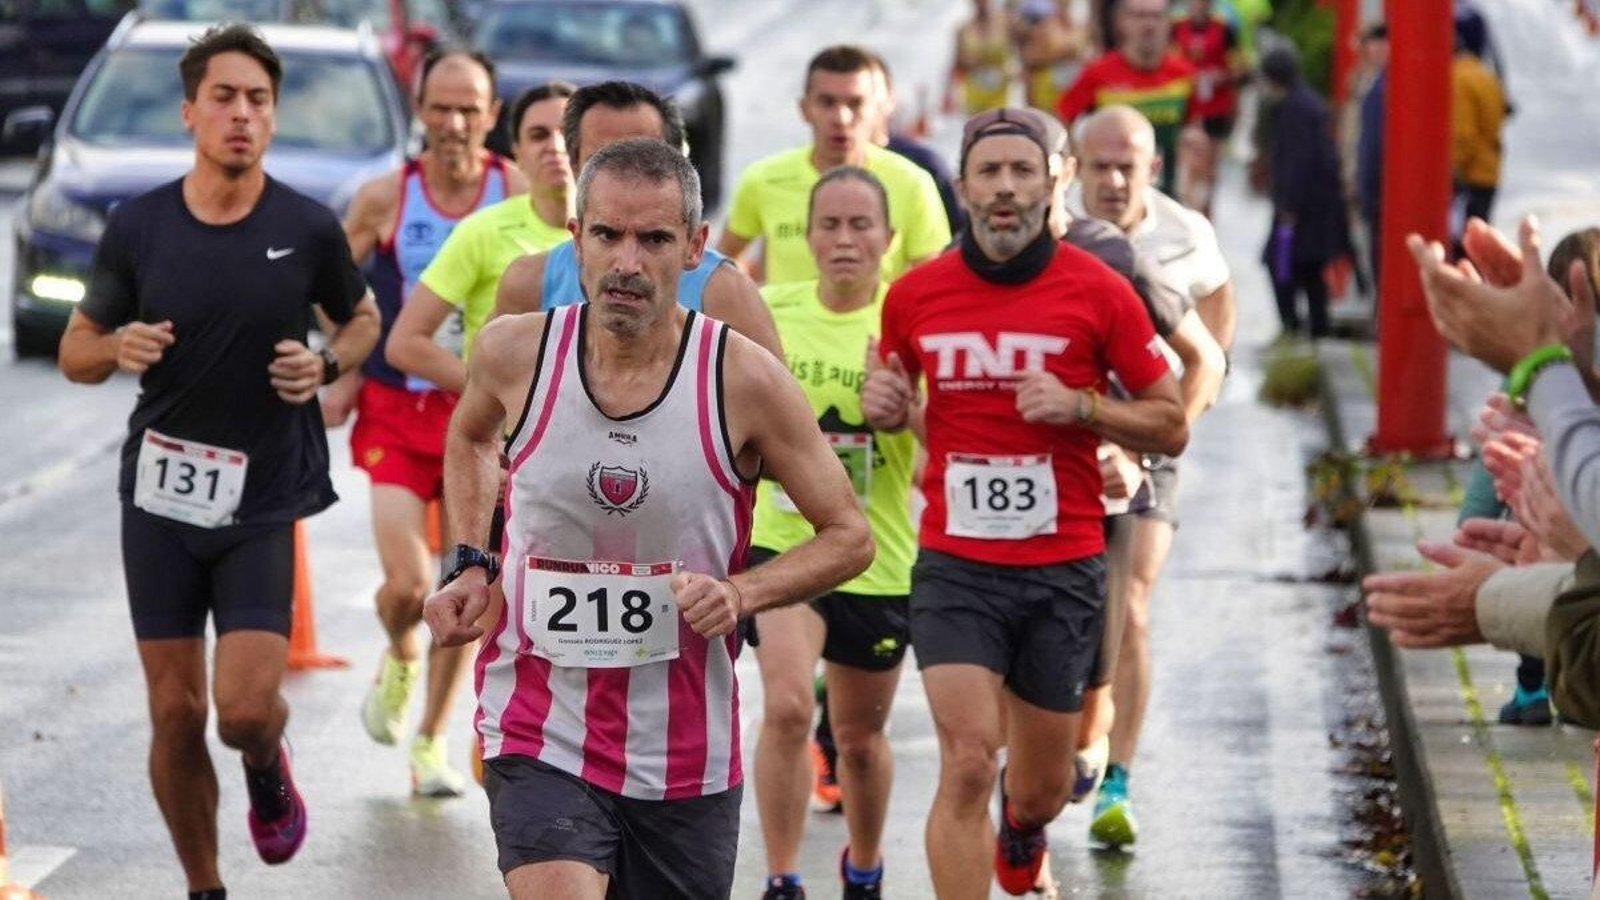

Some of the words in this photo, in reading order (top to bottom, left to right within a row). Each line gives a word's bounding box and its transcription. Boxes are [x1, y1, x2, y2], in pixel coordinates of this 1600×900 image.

[919, 331, 1071, 378] TNT
[155, 457, 220, 501] 131
[964, 477, 1036, 511] 183
[547, 586, 653, 633] 218
